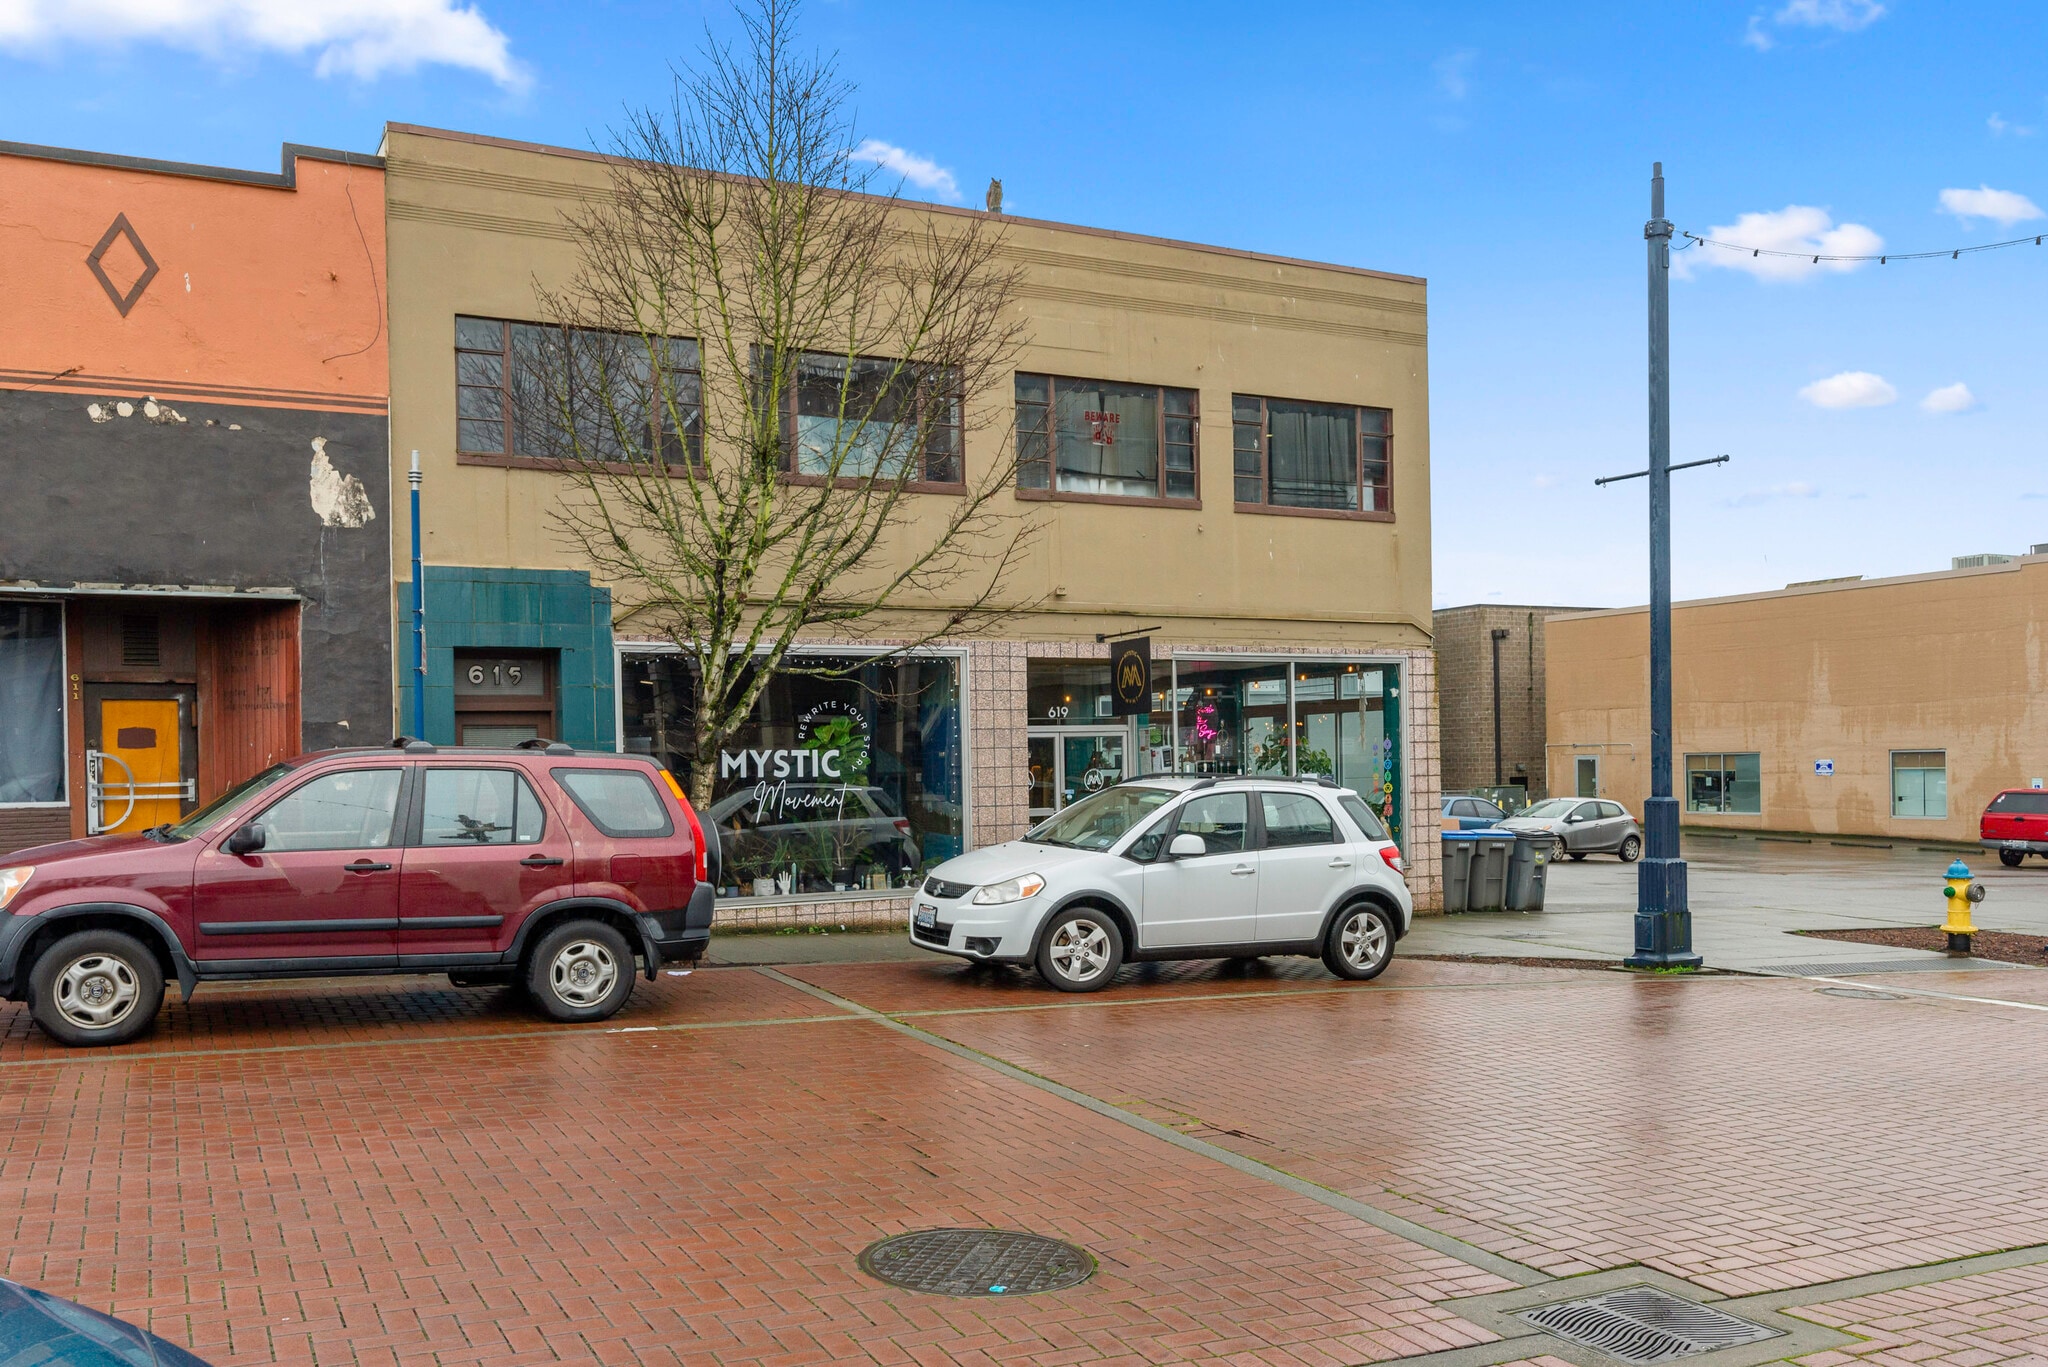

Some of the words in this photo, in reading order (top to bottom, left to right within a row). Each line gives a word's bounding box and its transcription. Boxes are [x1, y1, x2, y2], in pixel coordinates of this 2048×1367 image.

[1084, 410, 1121, 424] BEWARE
[70, 673, 80, 700] 611
[468, 664, 522, 686] 615
[798, 700, 837, 739] REWRITE
[843, 702, 868, 730] YOUR
[1048, 706, 1069, 718] 619
[721, 749, 841, 778] MYSTIC
[851, 735, 871, 772] STORY
[753, 779, 863, 824] Movement
